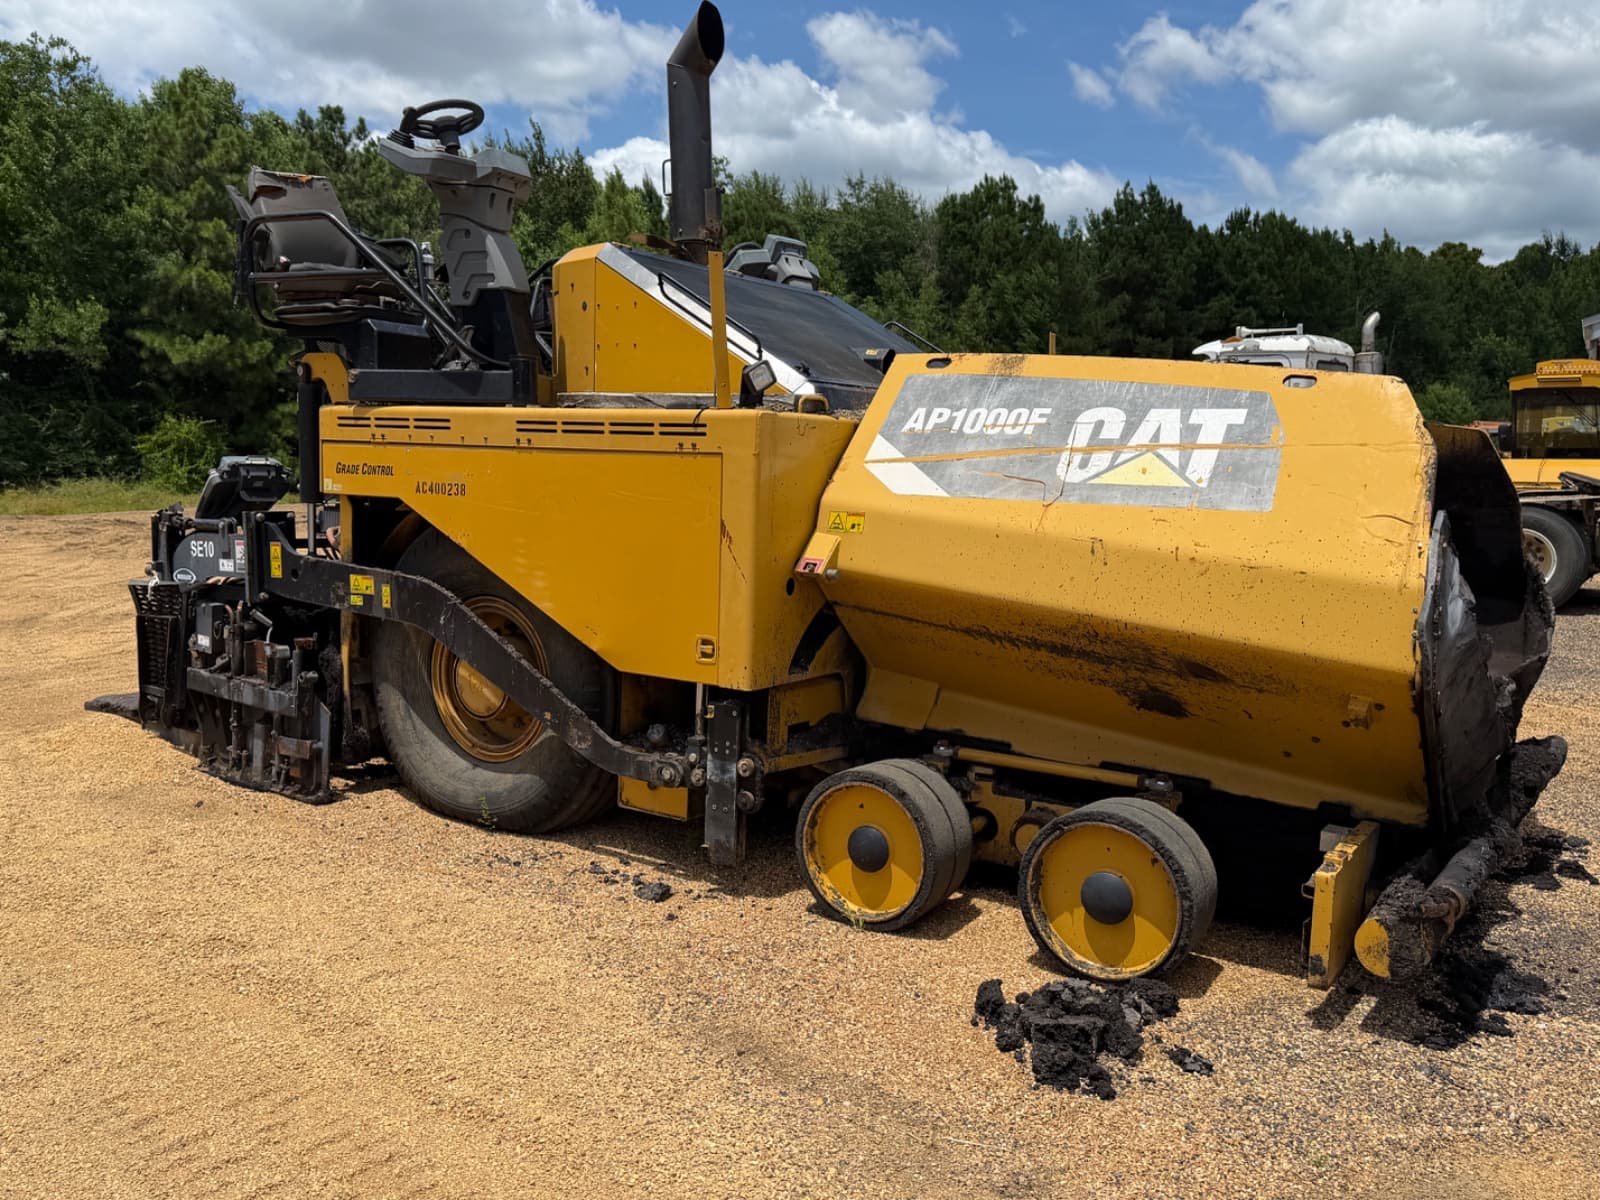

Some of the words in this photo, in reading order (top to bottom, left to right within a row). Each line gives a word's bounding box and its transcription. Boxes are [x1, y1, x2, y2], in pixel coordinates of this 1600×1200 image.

[901, 406, 1051, 435] AP1000F
[1056, 406, 1248, 488] CAT
[336, 462, 360, 476] GRADE
[362, 463, 395, 477] CONTROL
[415, 481, 466, 497] AC400238
[190, 540, 215, 558] SE10
